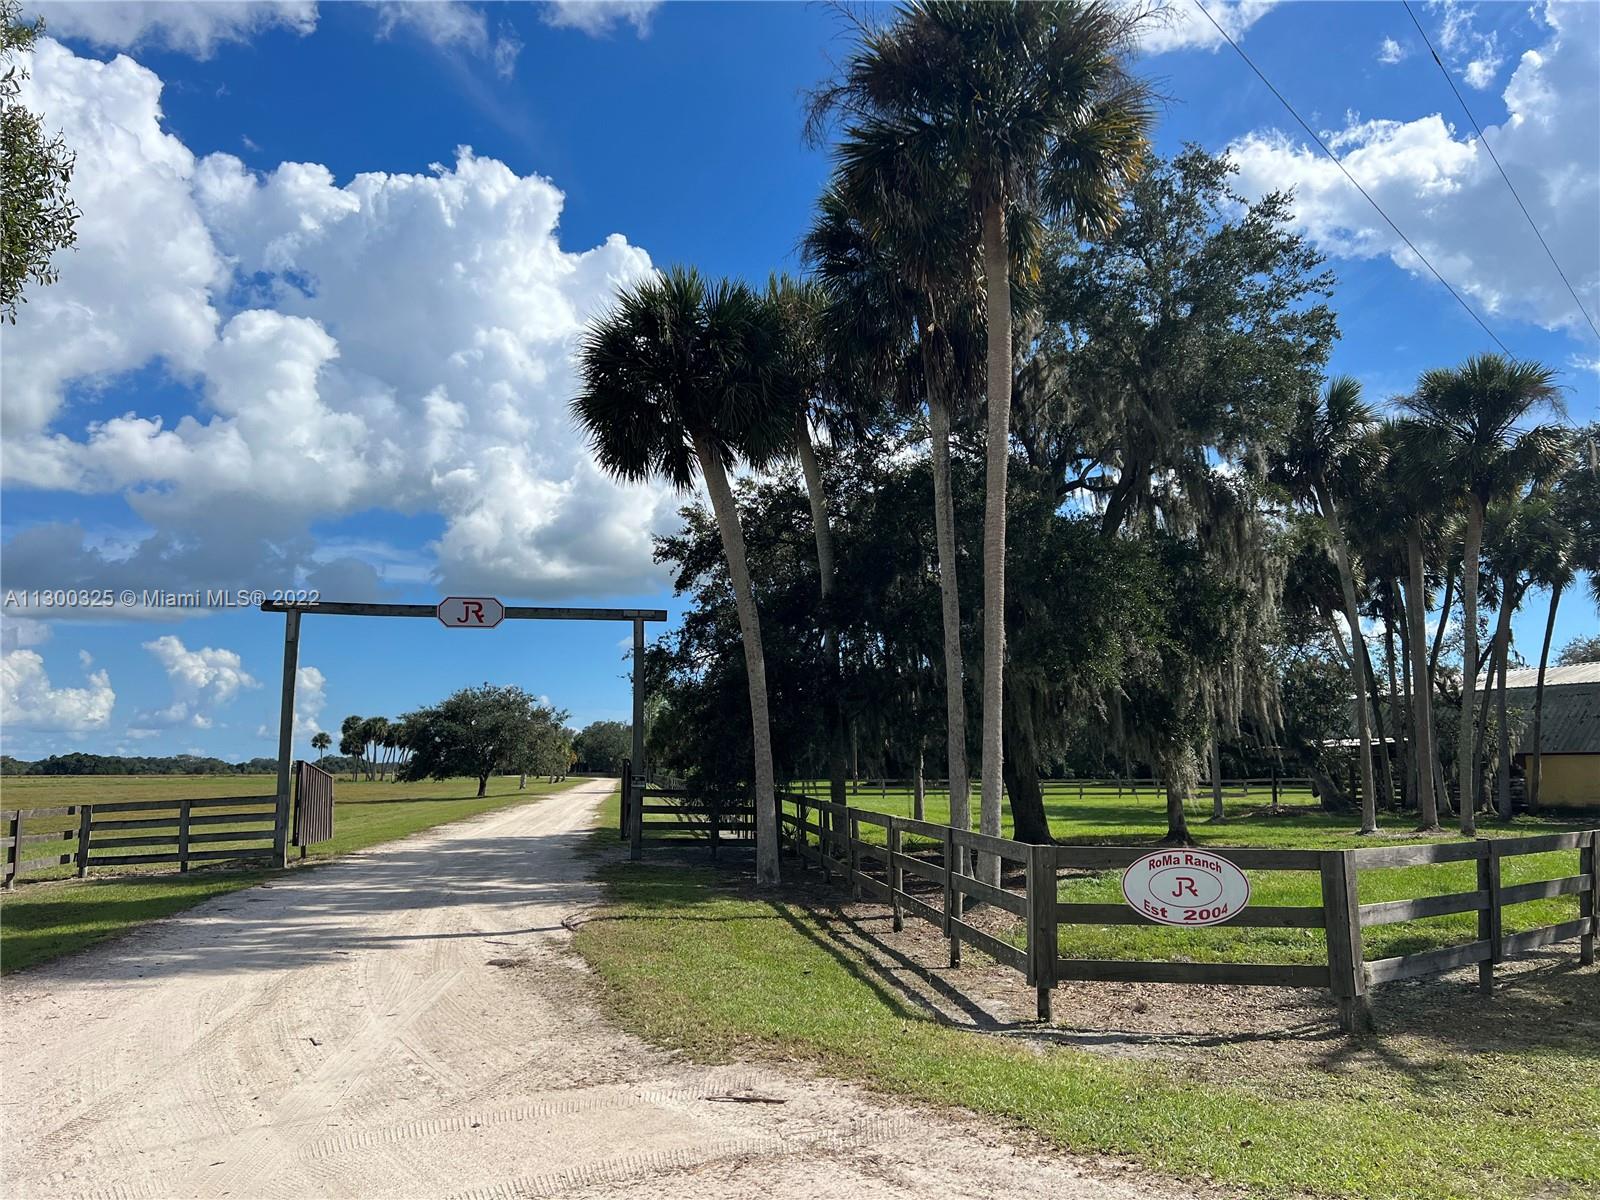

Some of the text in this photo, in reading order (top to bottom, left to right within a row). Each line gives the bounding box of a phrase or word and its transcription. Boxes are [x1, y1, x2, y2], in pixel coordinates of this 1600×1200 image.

[1149, 855, 1222, 873] RoMa Ranch
[1144, 899, 1228, 920] Est 2004
